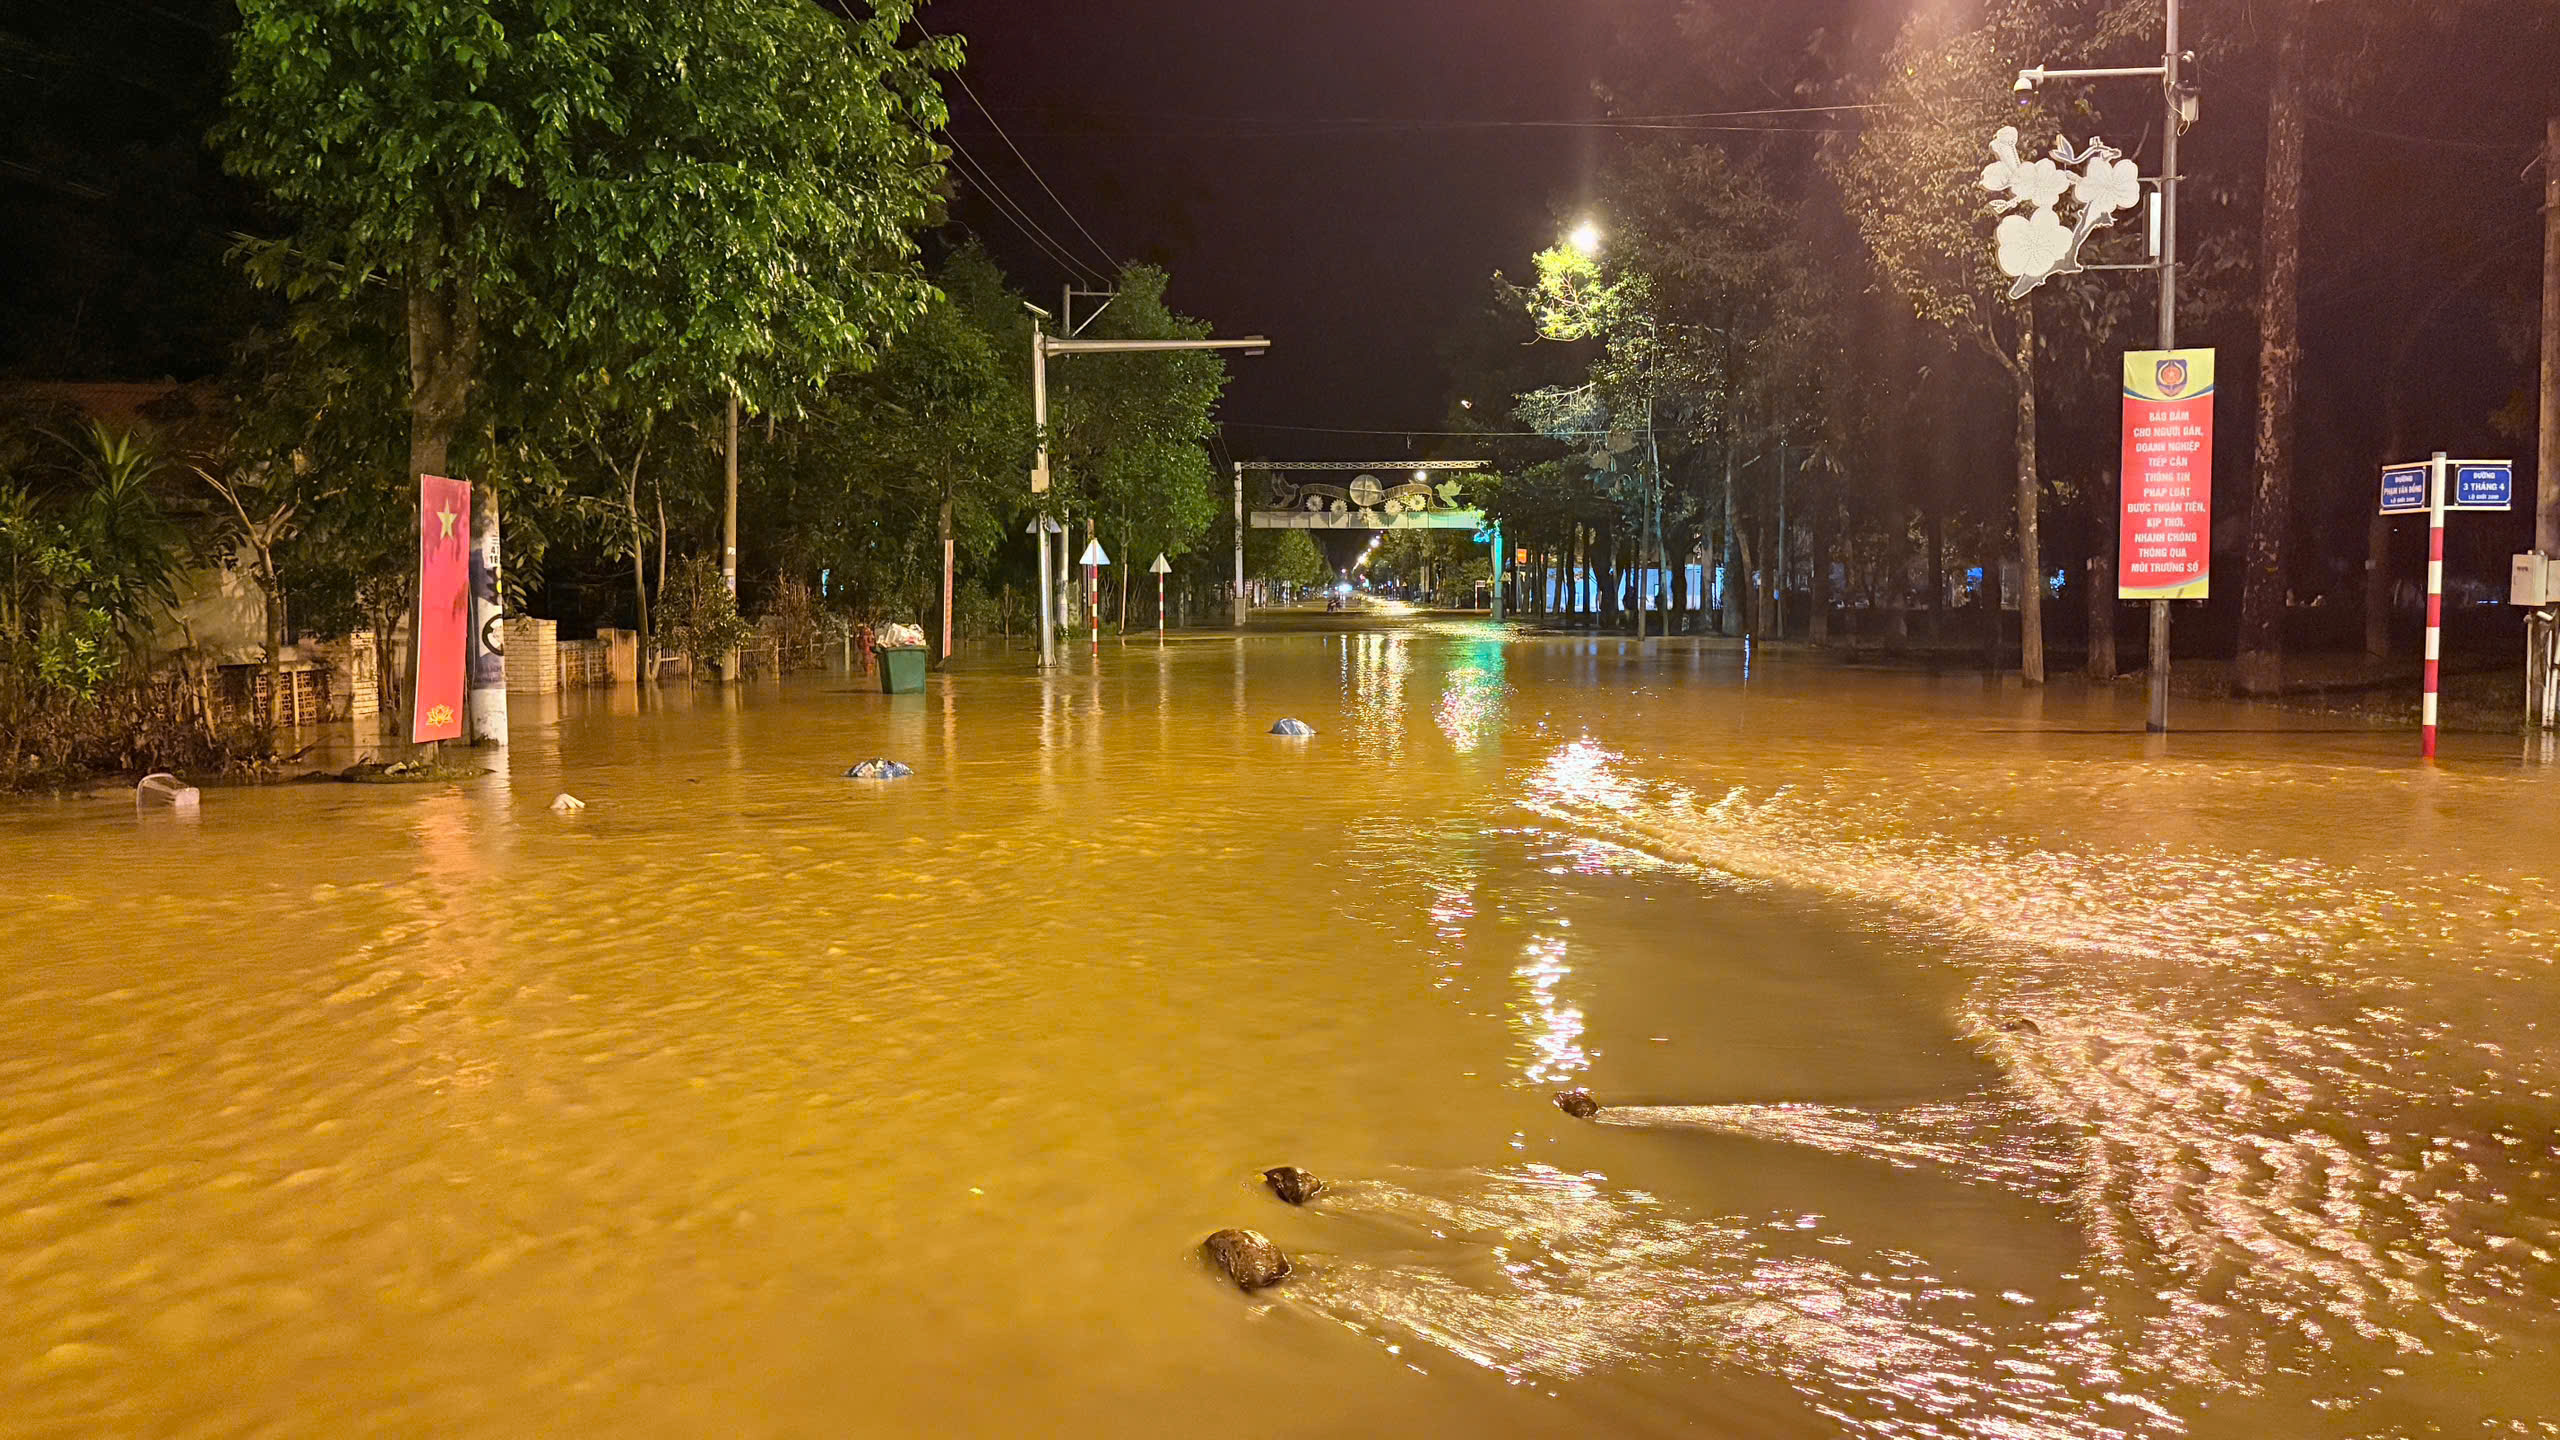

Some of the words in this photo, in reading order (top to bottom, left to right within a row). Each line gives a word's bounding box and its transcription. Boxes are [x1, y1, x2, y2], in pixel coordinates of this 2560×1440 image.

[2463, 482, 2469, 491] 3
[2470, 481, 2498, 491] THÁNG
[2498, 482, 2505, 491] 4
[2135, 532, 2165, 543] NHANH
[2169, 548, 2187, 558] QUA
